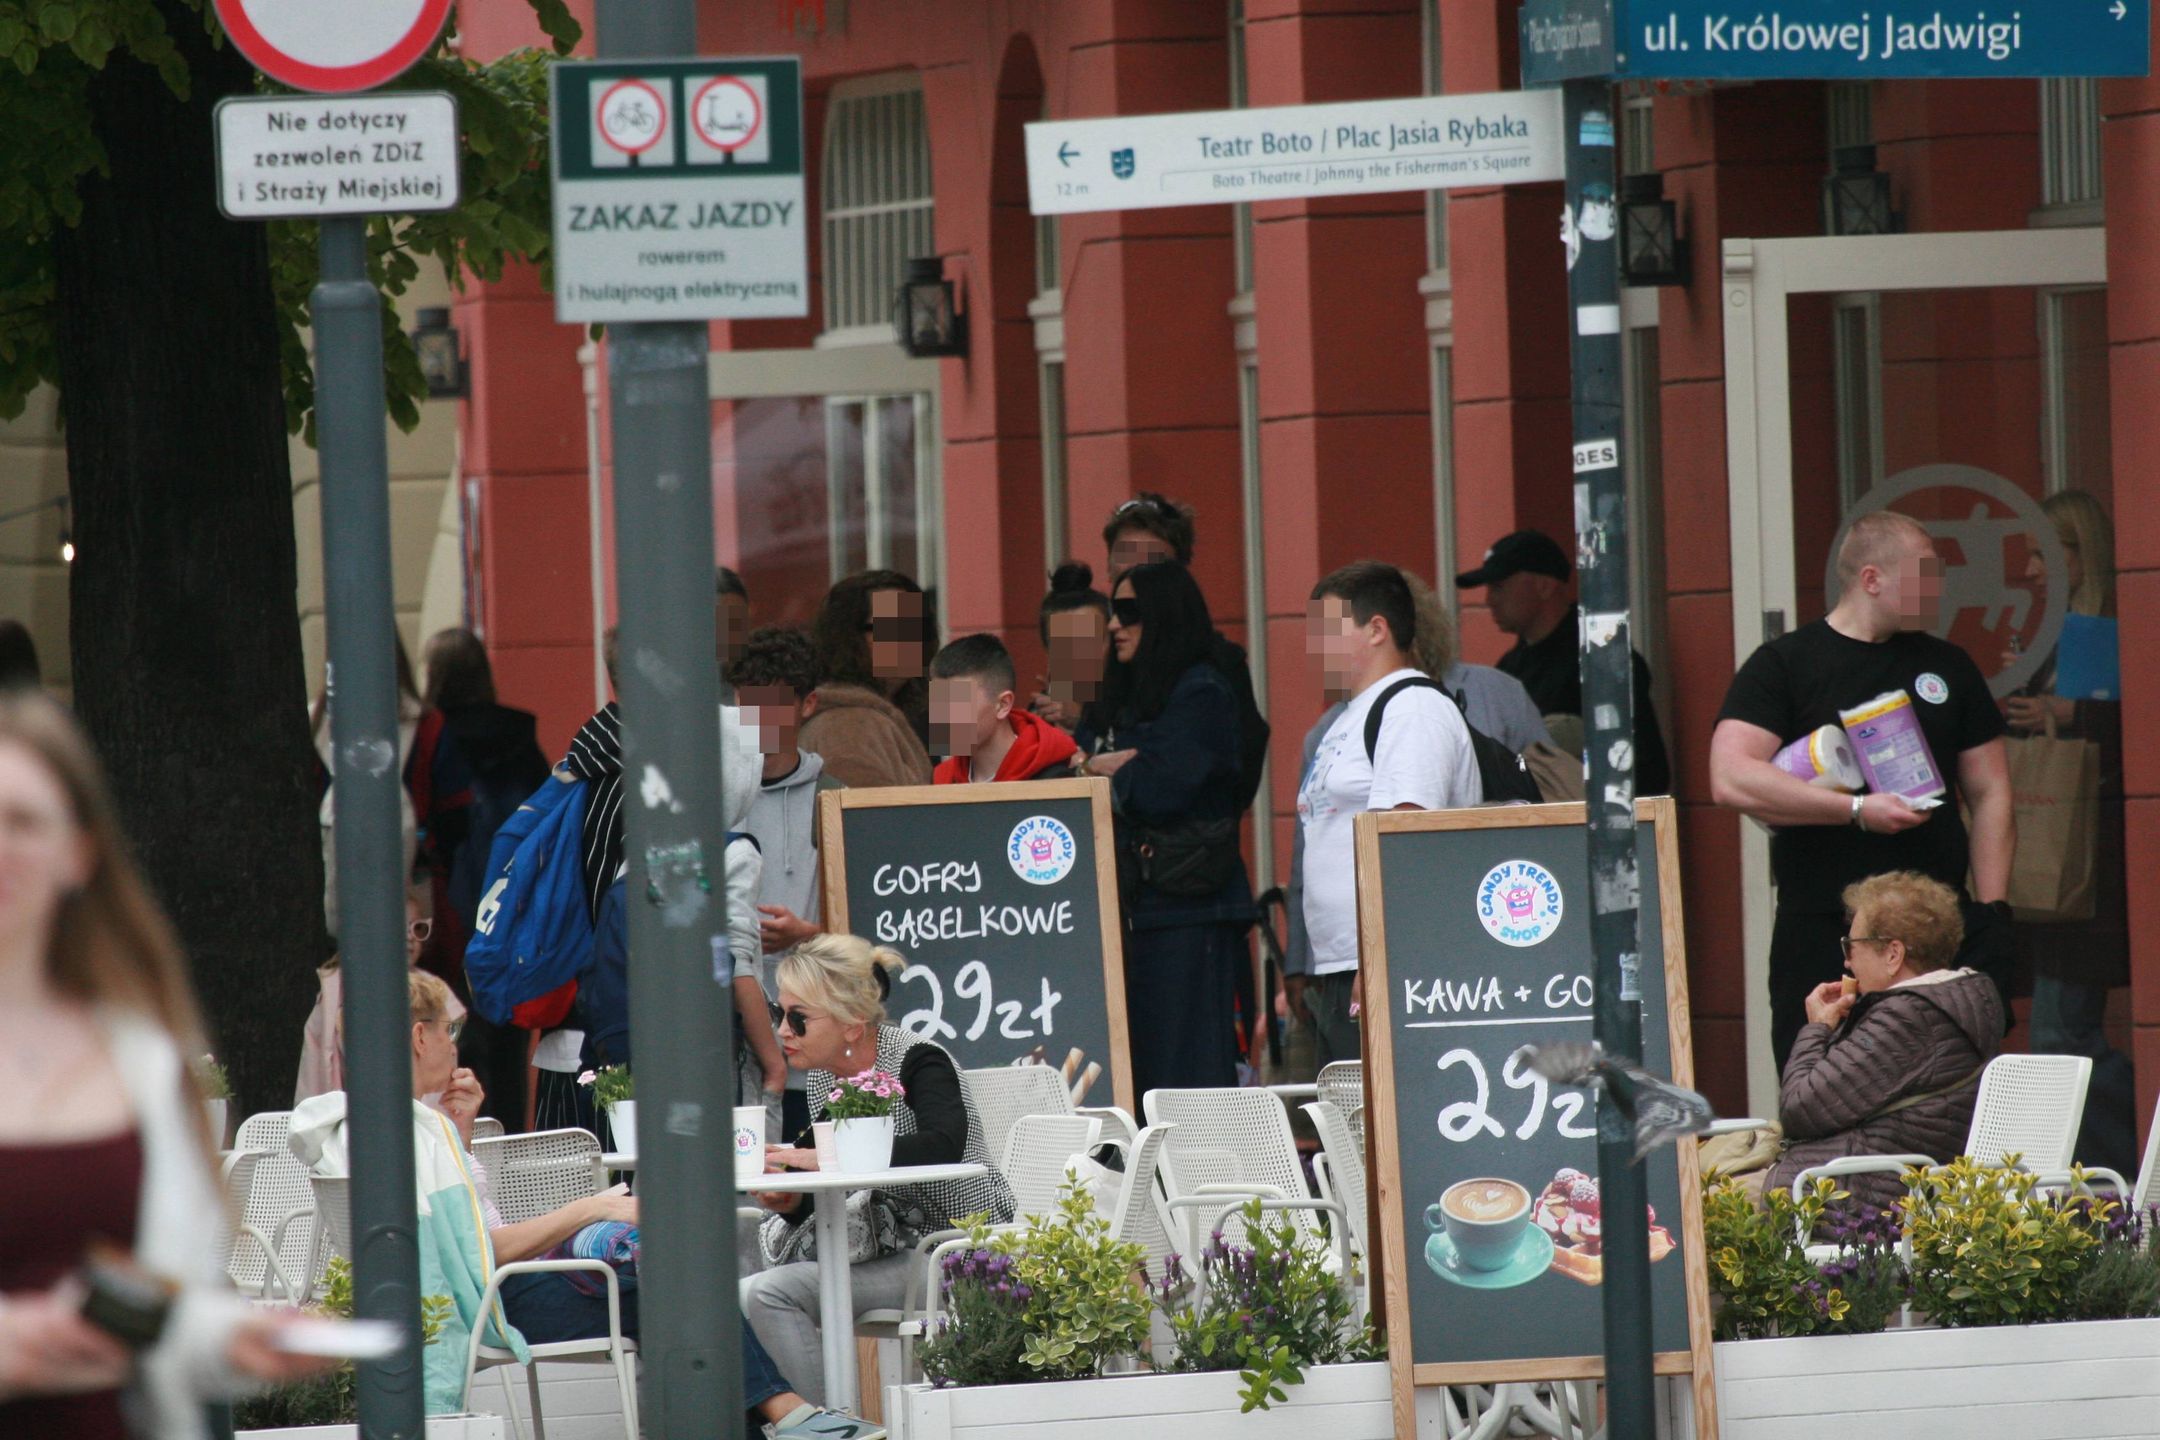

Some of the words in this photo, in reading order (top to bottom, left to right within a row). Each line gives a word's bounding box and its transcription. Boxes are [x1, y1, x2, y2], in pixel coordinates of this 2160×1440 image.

[1644, 13, 1689, 52] ul.
[1703, 12, 1871, 61] Królowej
[1880, 12, 2021, 61] Jadwigi
[267, 113, 307, 131] Nie
[317, 111, 407, 134] dotyczy
[1199, 136, 1253, 159] Teatr
[1261, 131, 1312, 155] Boto
[1321, 128, 1328, 153] /
[1336, 123, 1381, 149] Plac
[1388, 119, 1441, 150] Jasia
[1448, 113, 1529, 147] Rybaka
[253, 144, 362, 167] zezwoleń
[372, 141, 424, 163] ZDiZ
[1212, 173, 1245, 188] Boto
[1250, 166, 1301, 185] Theatre
[1314, 164, 1364, 184] Johnny
[1369, 162, 1391, 179] the
[1395, 157, 1480, 176] Fisherman's
[1482, 153, 1532, 172] Square
[238, 182, 244, 202] i
[255, 181, 327, 204] Straży
[338, 175, 442, 200] Miejskiej
[1056, 183, 1072, 195] 12
[1075, 183, 1089, 194] m
[568, 204, 679, 232] ZAKAZ
[688, 201, 794, 229] JAZDY
[638, 250, 726, 266] rowerem
[579, 284, 678, 304] hulajnogą
[683, 279, 799, 301] elektryczną
[1575, 447, 1614, 466] GES
[1011, 820, 1034, 861] CANDY
[1040, 819, 1072, 860] TRENDY
[873, 861, 982, 896] GOFRY
[1026, 868, 1058, 880] SHOP
[1481, 865, 1511, 917] CANDY
[1517, 863, 1559, 916] TRENDY
[876, 900, 1075, 949] BĄBELKOWE
[1500, 925, 1541, 941] SHOP
[1404, 976, 1505, 1014] KAWA
[1514, 985, 1532, 1002] +
[1544, 974, 1594, 1008] GO
[1437, 1044, 1600, 1142] 29z
